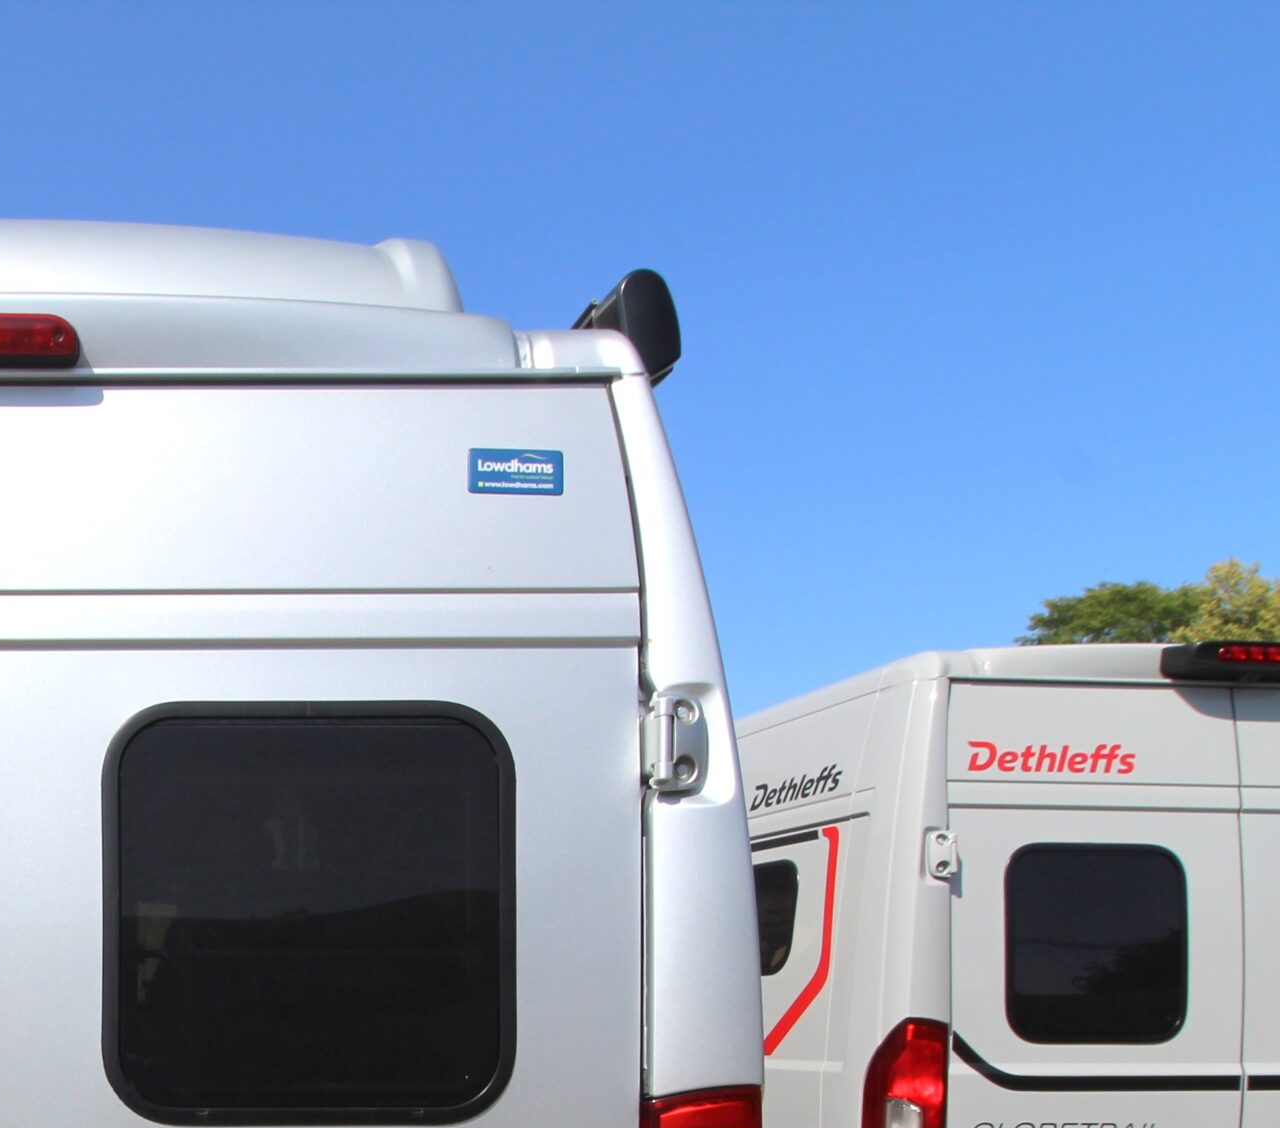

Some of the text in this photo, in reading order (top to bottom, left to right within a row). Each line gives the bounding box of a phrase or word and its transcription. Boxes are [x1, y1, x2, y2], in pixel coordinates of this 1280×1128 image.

[477, 458, 554, 474] Lowdhams
[484, 481, 554, 489] www.lowdhams.com
[967, 741, 1136, 775] Dethleffs
[749, 763, 844, 812] Dethleffs
